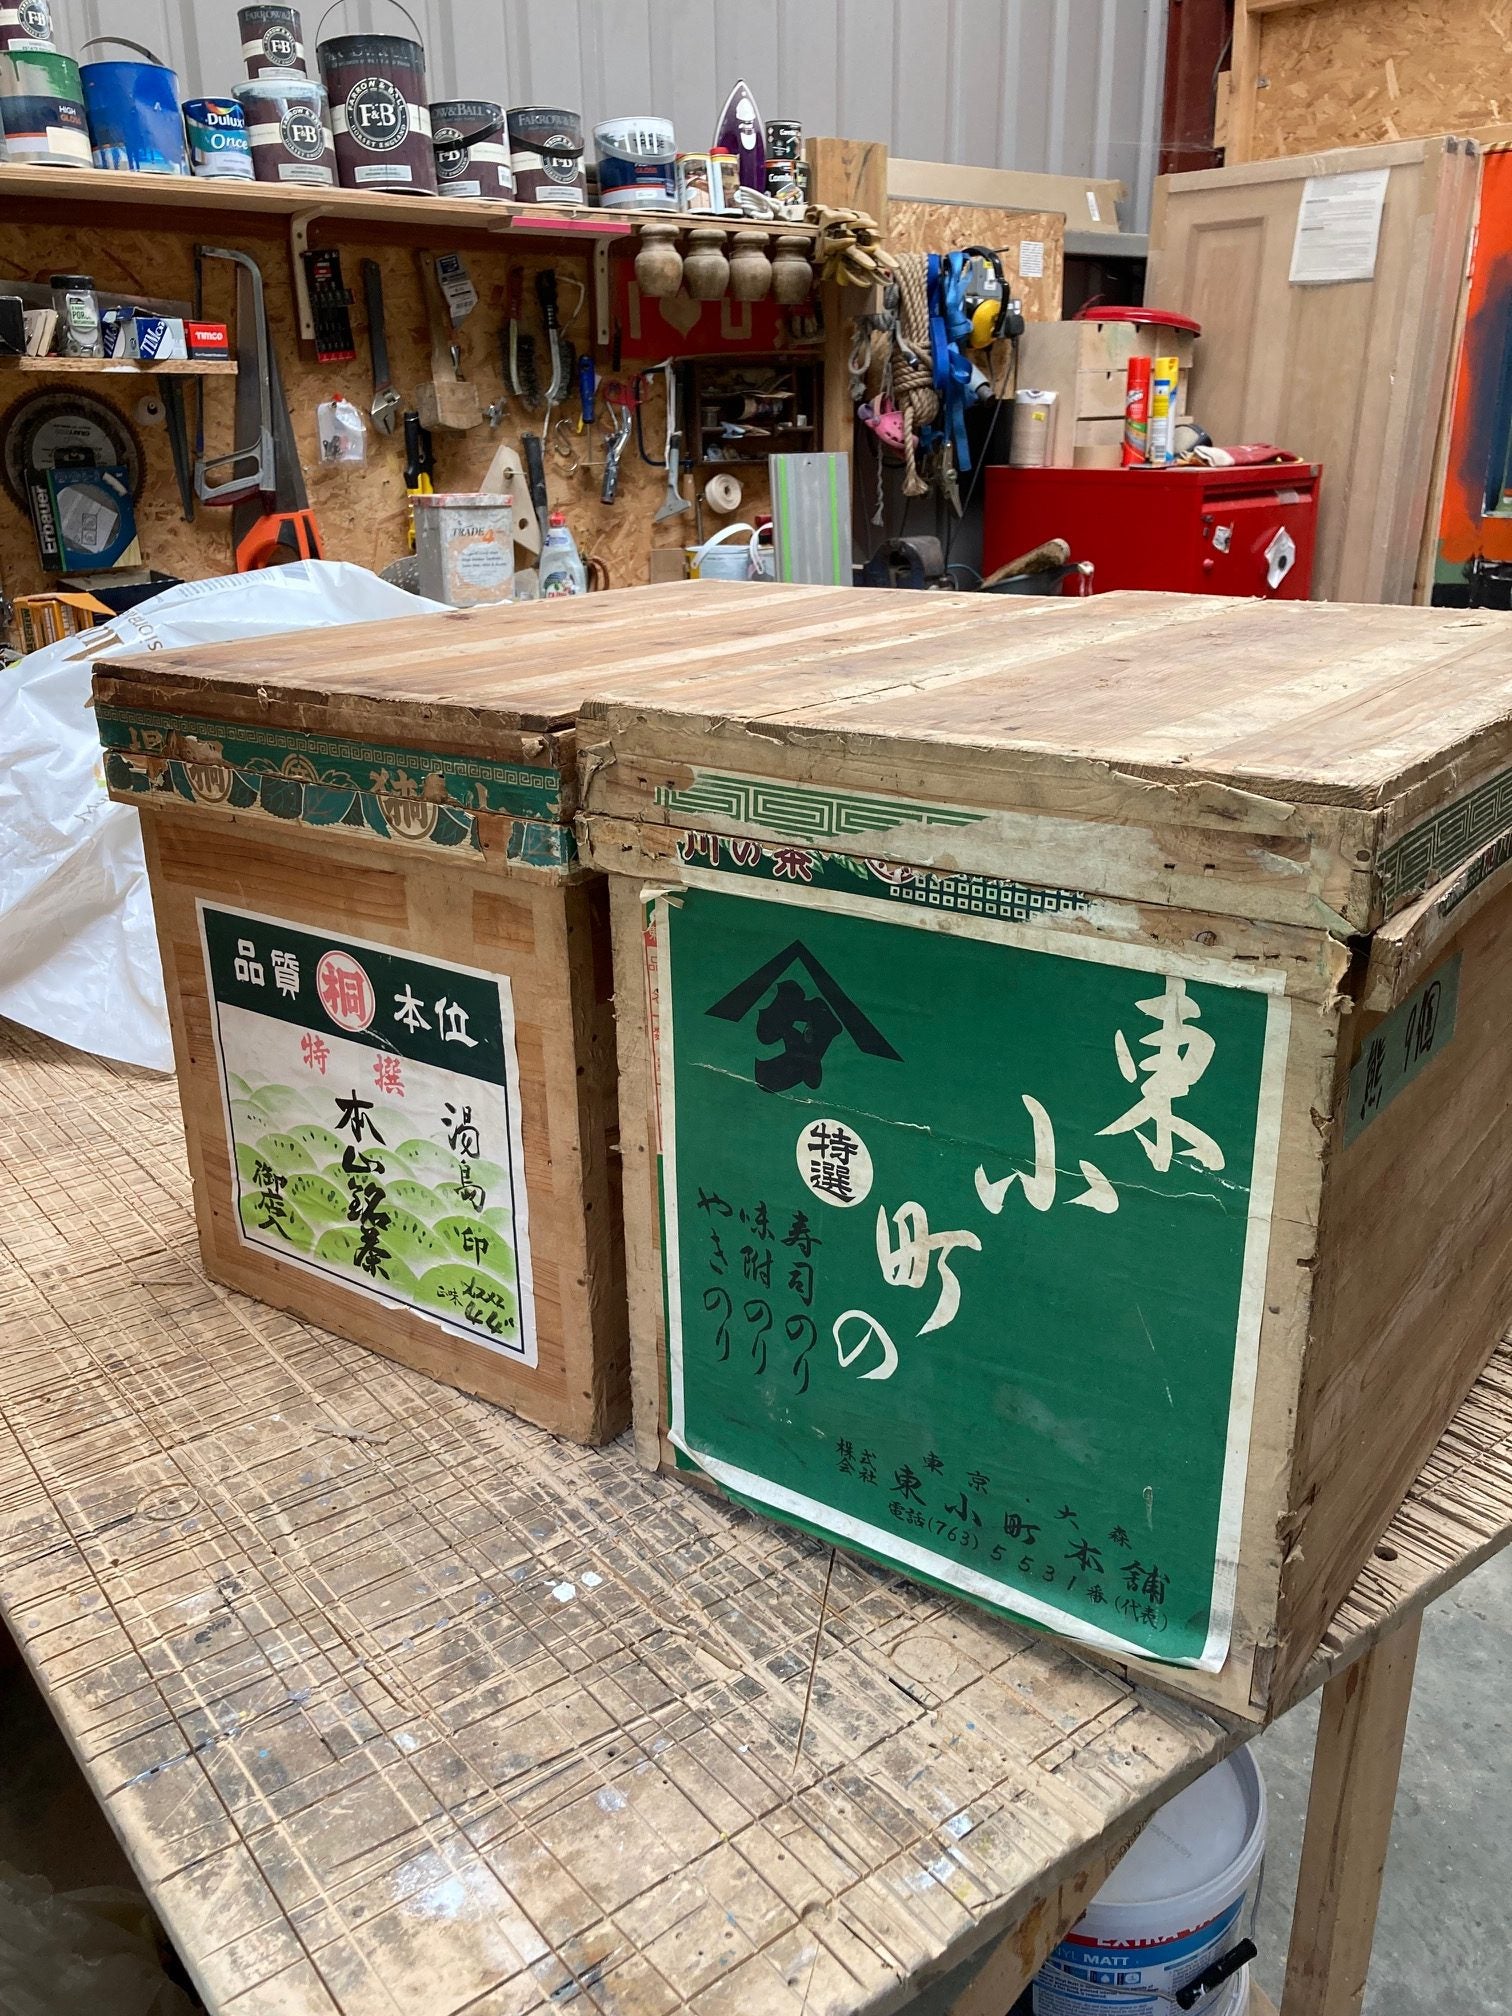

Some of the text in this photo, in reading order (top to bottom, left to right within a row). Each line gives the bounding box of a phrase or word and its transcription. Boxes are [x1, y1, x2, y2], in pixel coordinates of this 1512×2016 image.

[207, 112, 243, 129] Dulux
[358, 103, 397, 127] F&B
[210, 133, 249, 151] Once
[290, 124, 318, 143] F&B
[233, 938, 480, 1049] 品質 桐 本位
[807, 1121, 860, 1204] 特選
[1083, 1952, 1130, 1967] MATT
